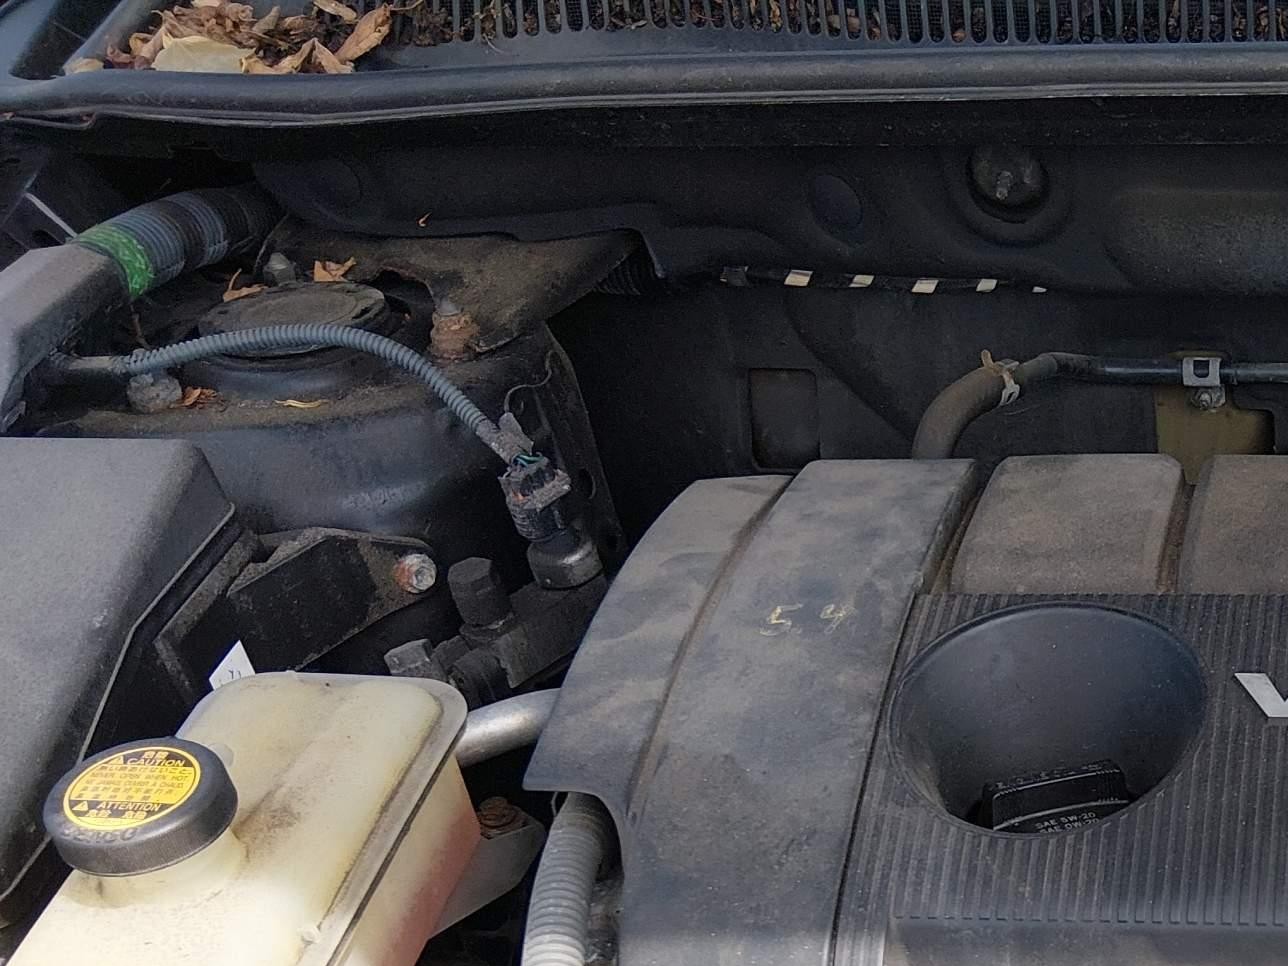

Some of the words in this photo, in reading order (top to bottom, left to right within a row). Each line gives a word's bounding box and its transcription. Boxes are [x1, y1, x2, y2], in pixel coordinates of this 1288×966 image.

[126, 758, 186, 767] CAUTION
[96, 801, 162, 812] ATTENTION
[1035, 819, 1058, 829] SAE
[1060, 811, 1097, 824] 5W-20
